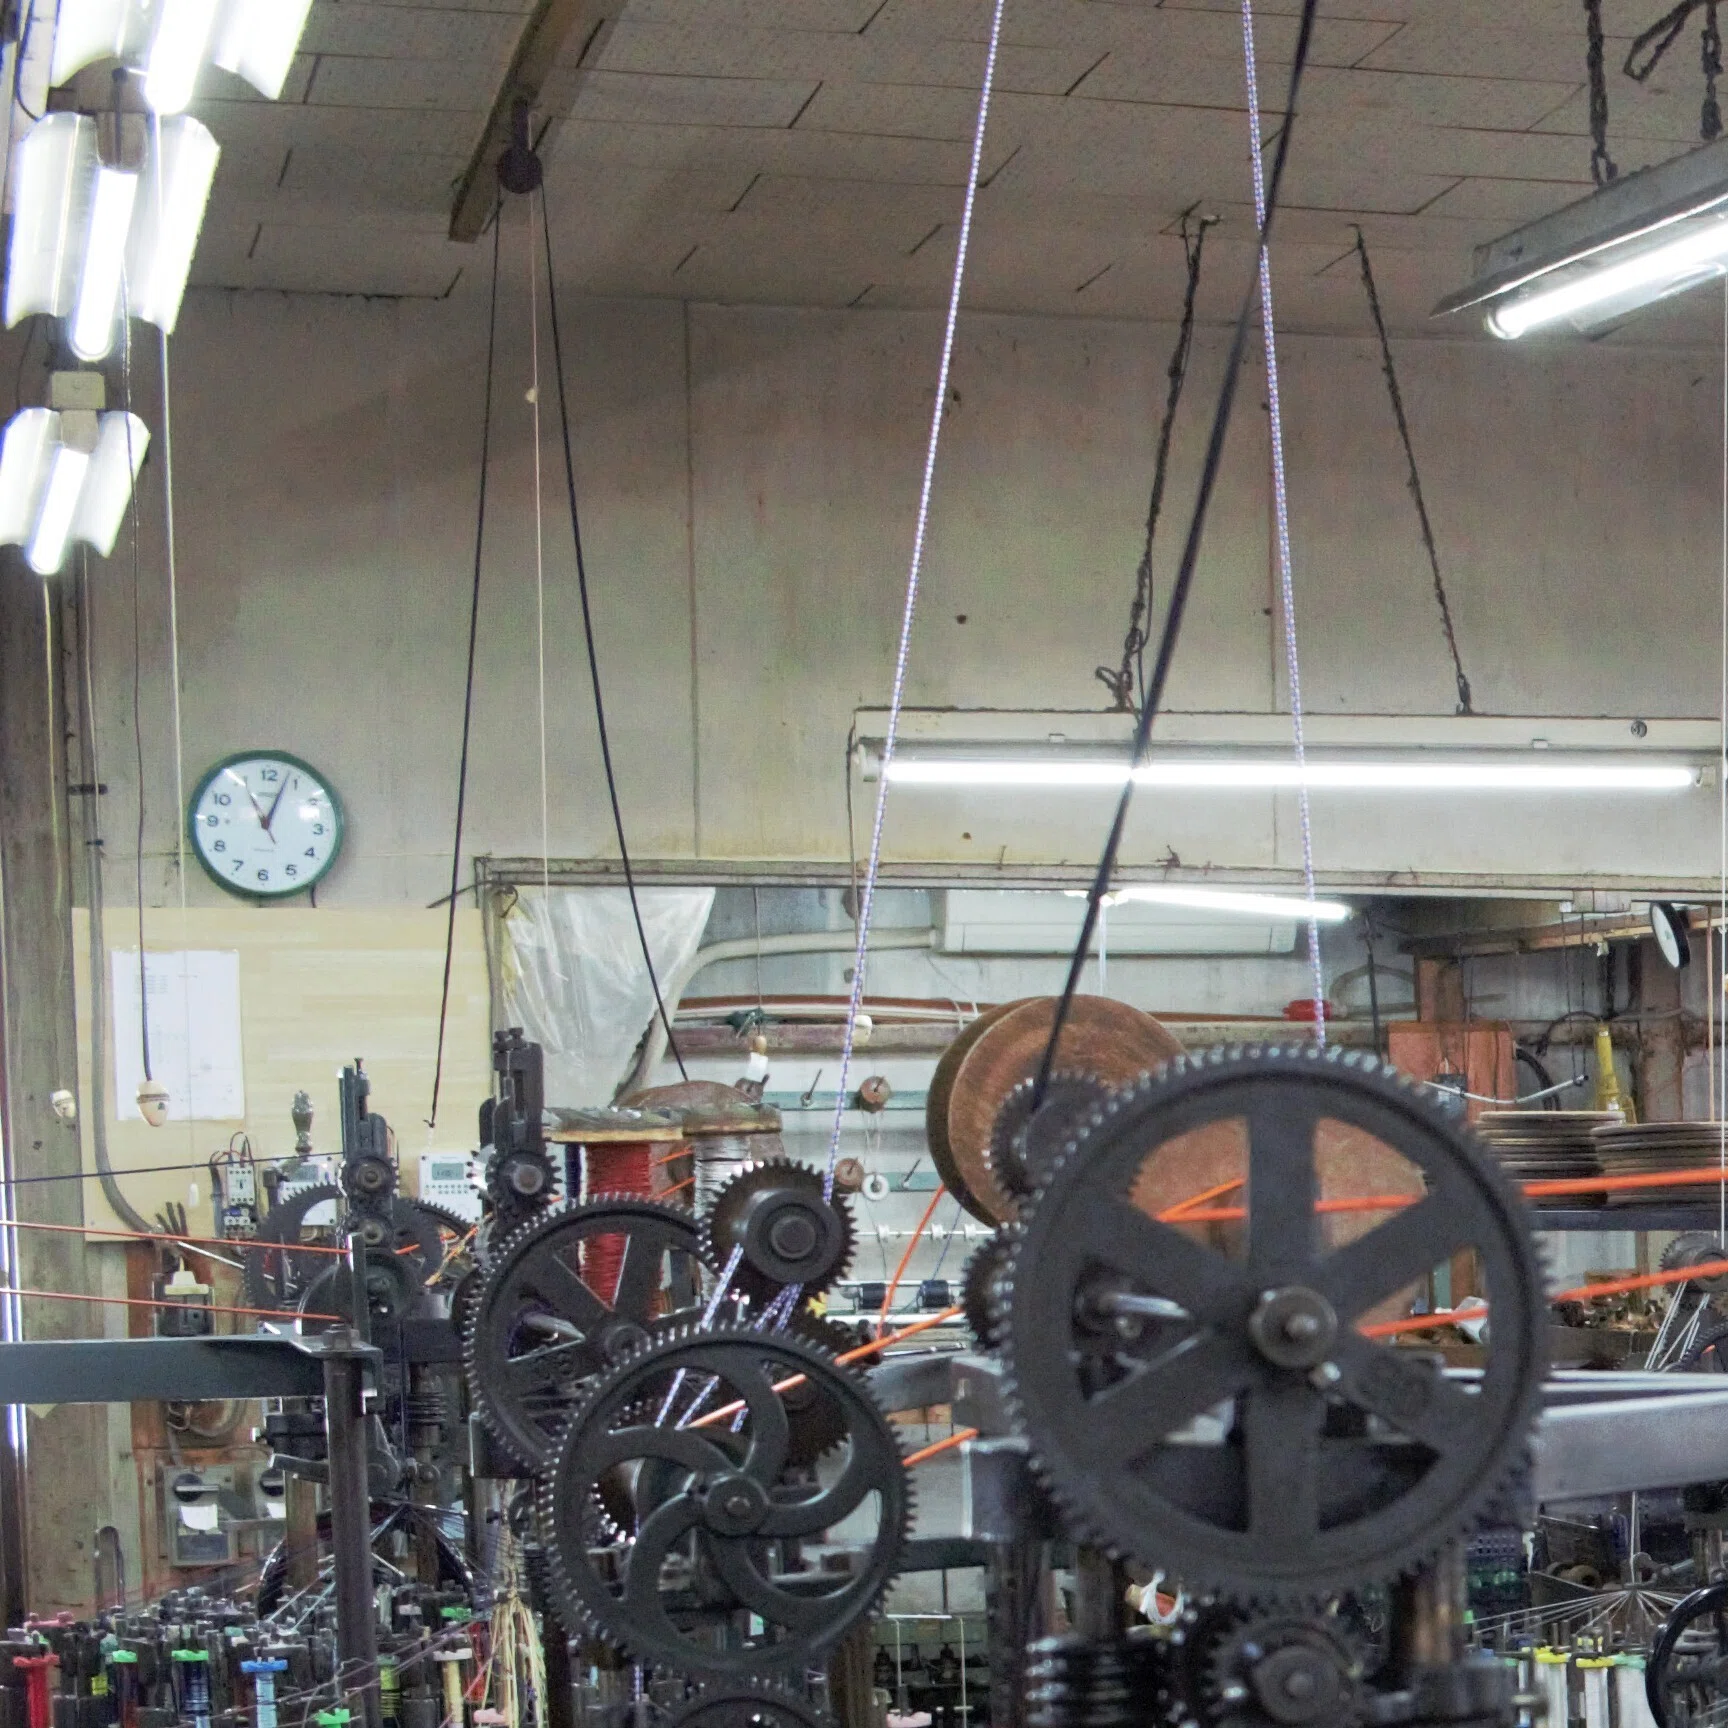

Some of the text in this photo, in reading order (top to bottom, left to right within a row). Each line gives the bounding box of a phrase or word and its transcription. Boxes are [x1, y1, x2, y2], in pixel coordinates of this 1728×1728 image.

[261, 769, 278, 781] 12
[213, 794, 231, 806] 10
[206, 815, 219, 827] 9
[313, 823, 324, 836] 3
[214, 840, 226, 852] 8
[304, 846, 315, 858] 4
[232, 859, 244, 871] 7
[285, 864, 297, 876] 5
[257, 869, 269, 881] 6
